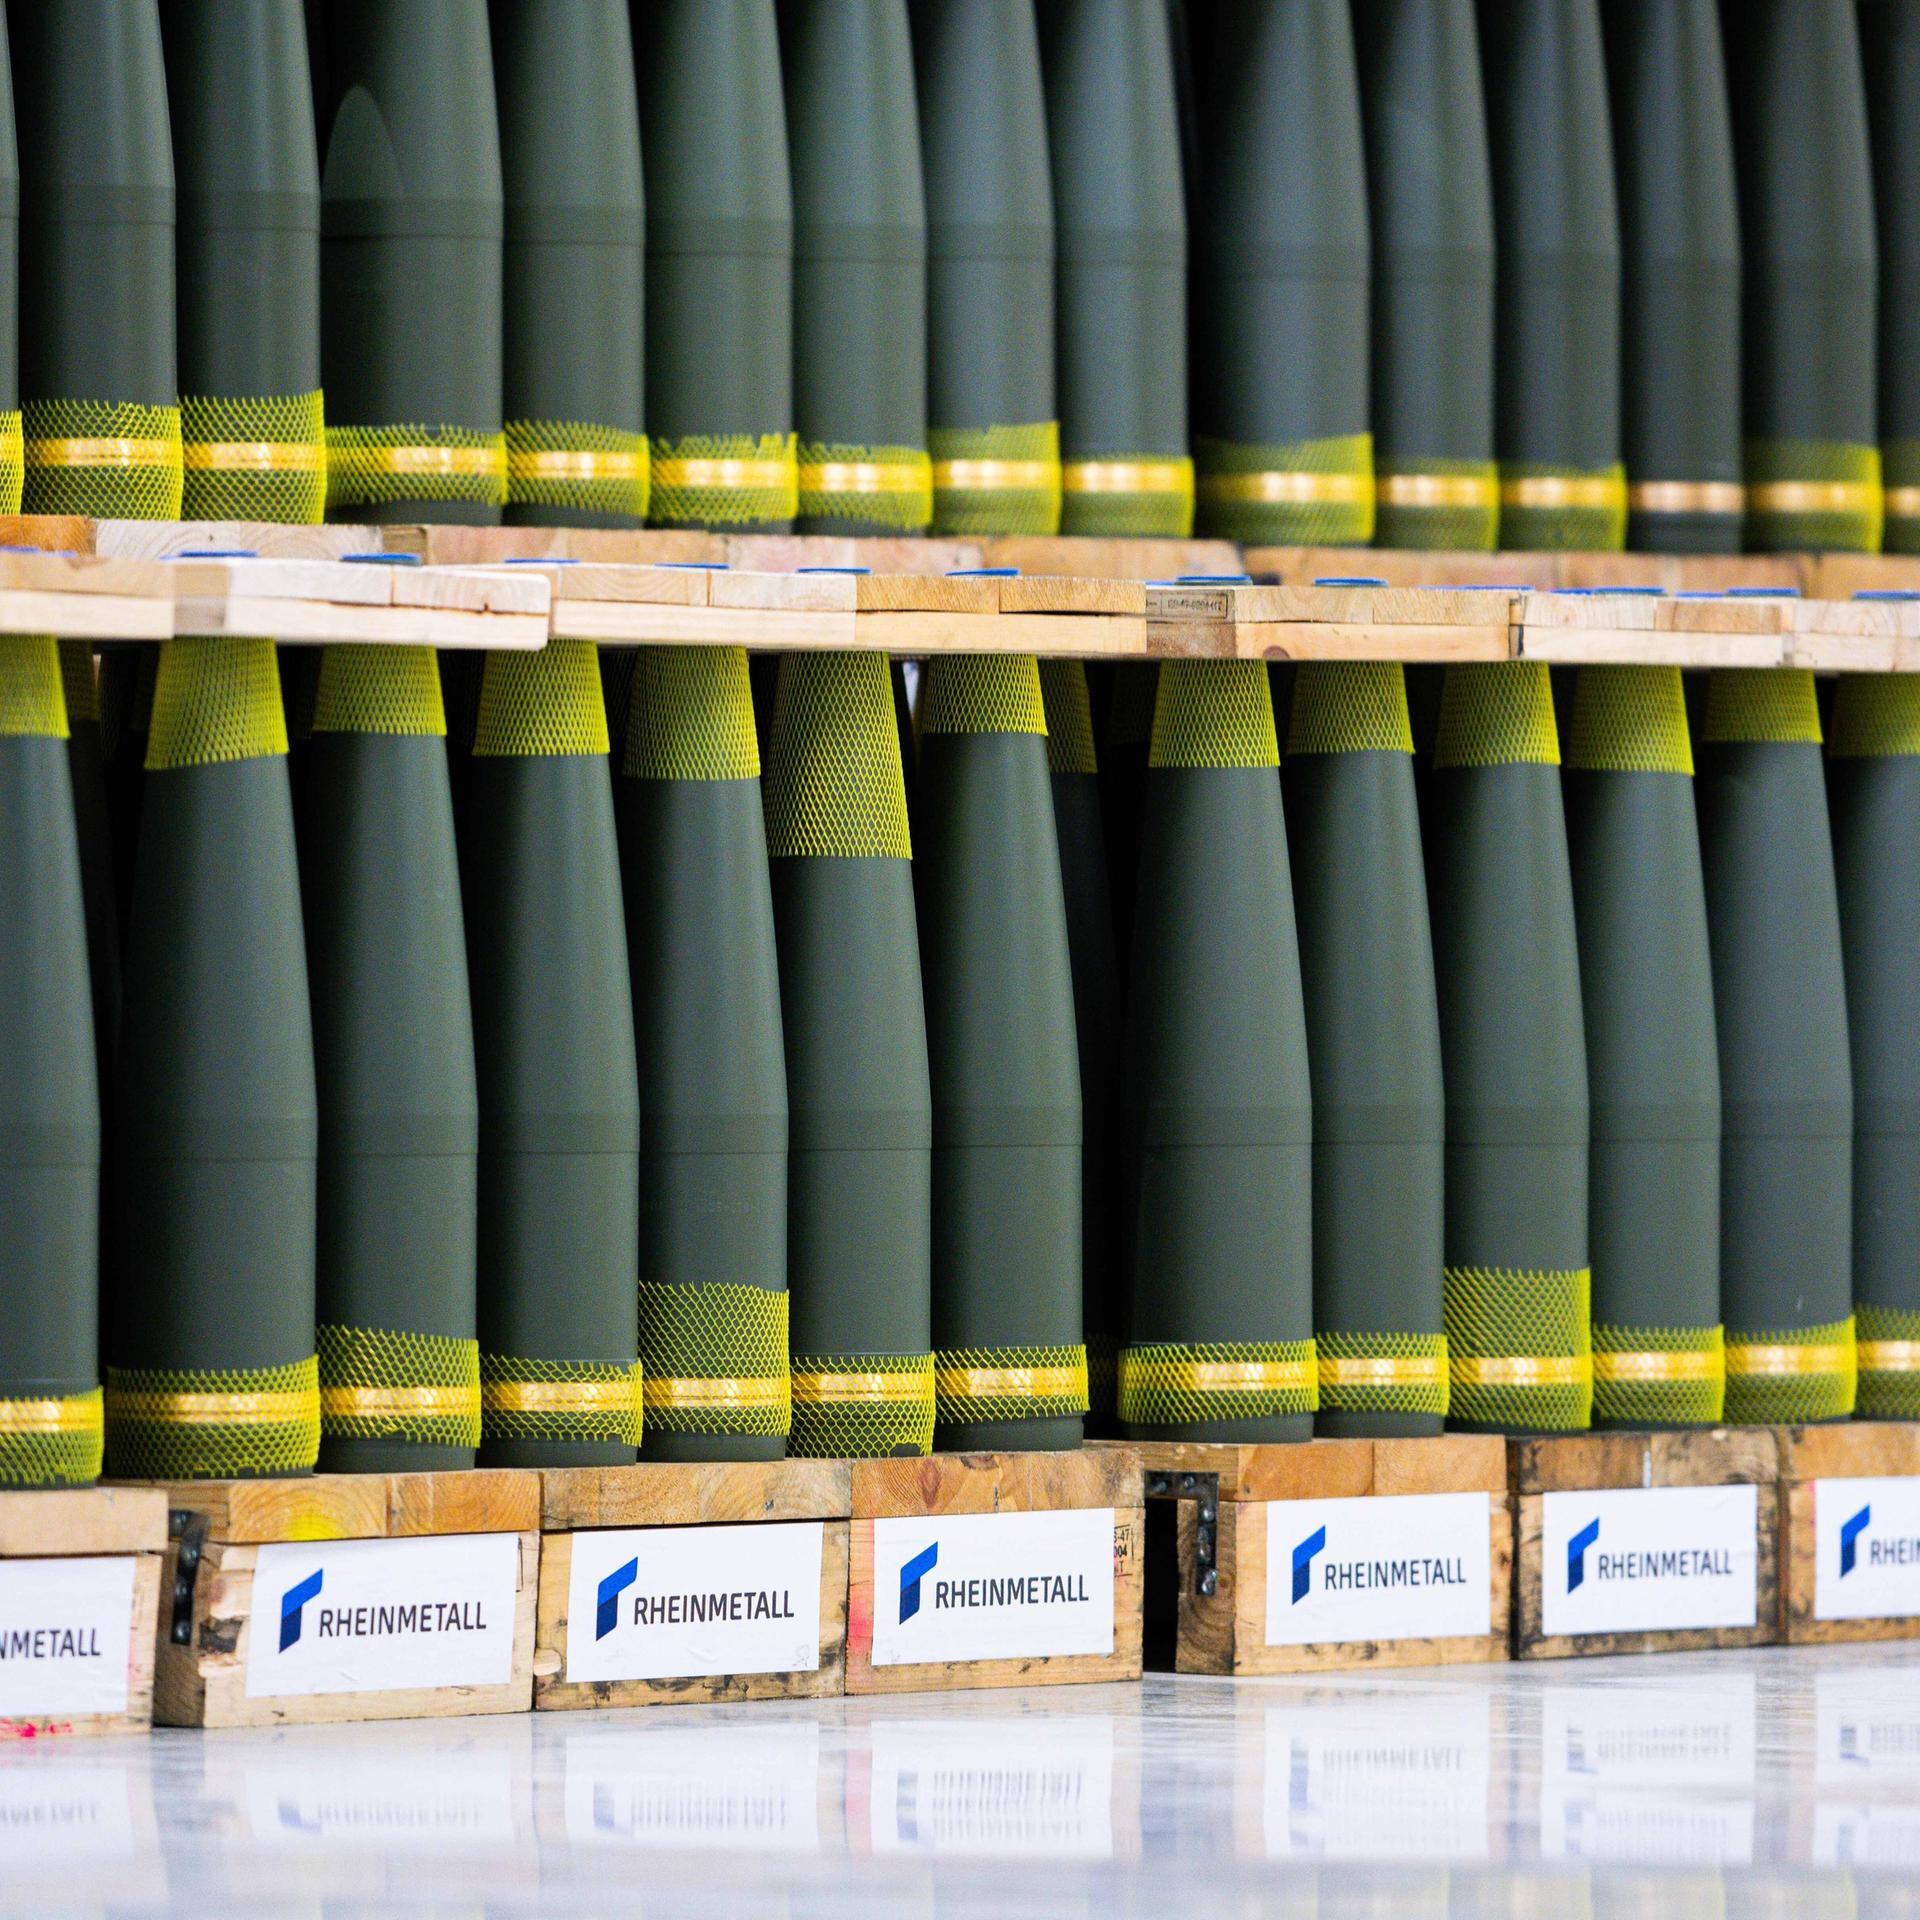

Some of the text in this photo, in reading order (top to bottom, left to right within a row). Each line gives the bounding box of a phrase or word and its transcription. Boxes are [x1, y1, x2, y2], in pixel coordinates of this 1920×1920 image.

[1325, 1558, 1466, 1590] RHEINMETALL
[1599, 1551, 1732, 1580] RHEINMETALL
[633, 1589, 795, 1626] RHEINMETALL
[935, 1574, 1089, 1609] RHEINMETALL
[319, 1602, 487, 1638] RHEINMETALL
